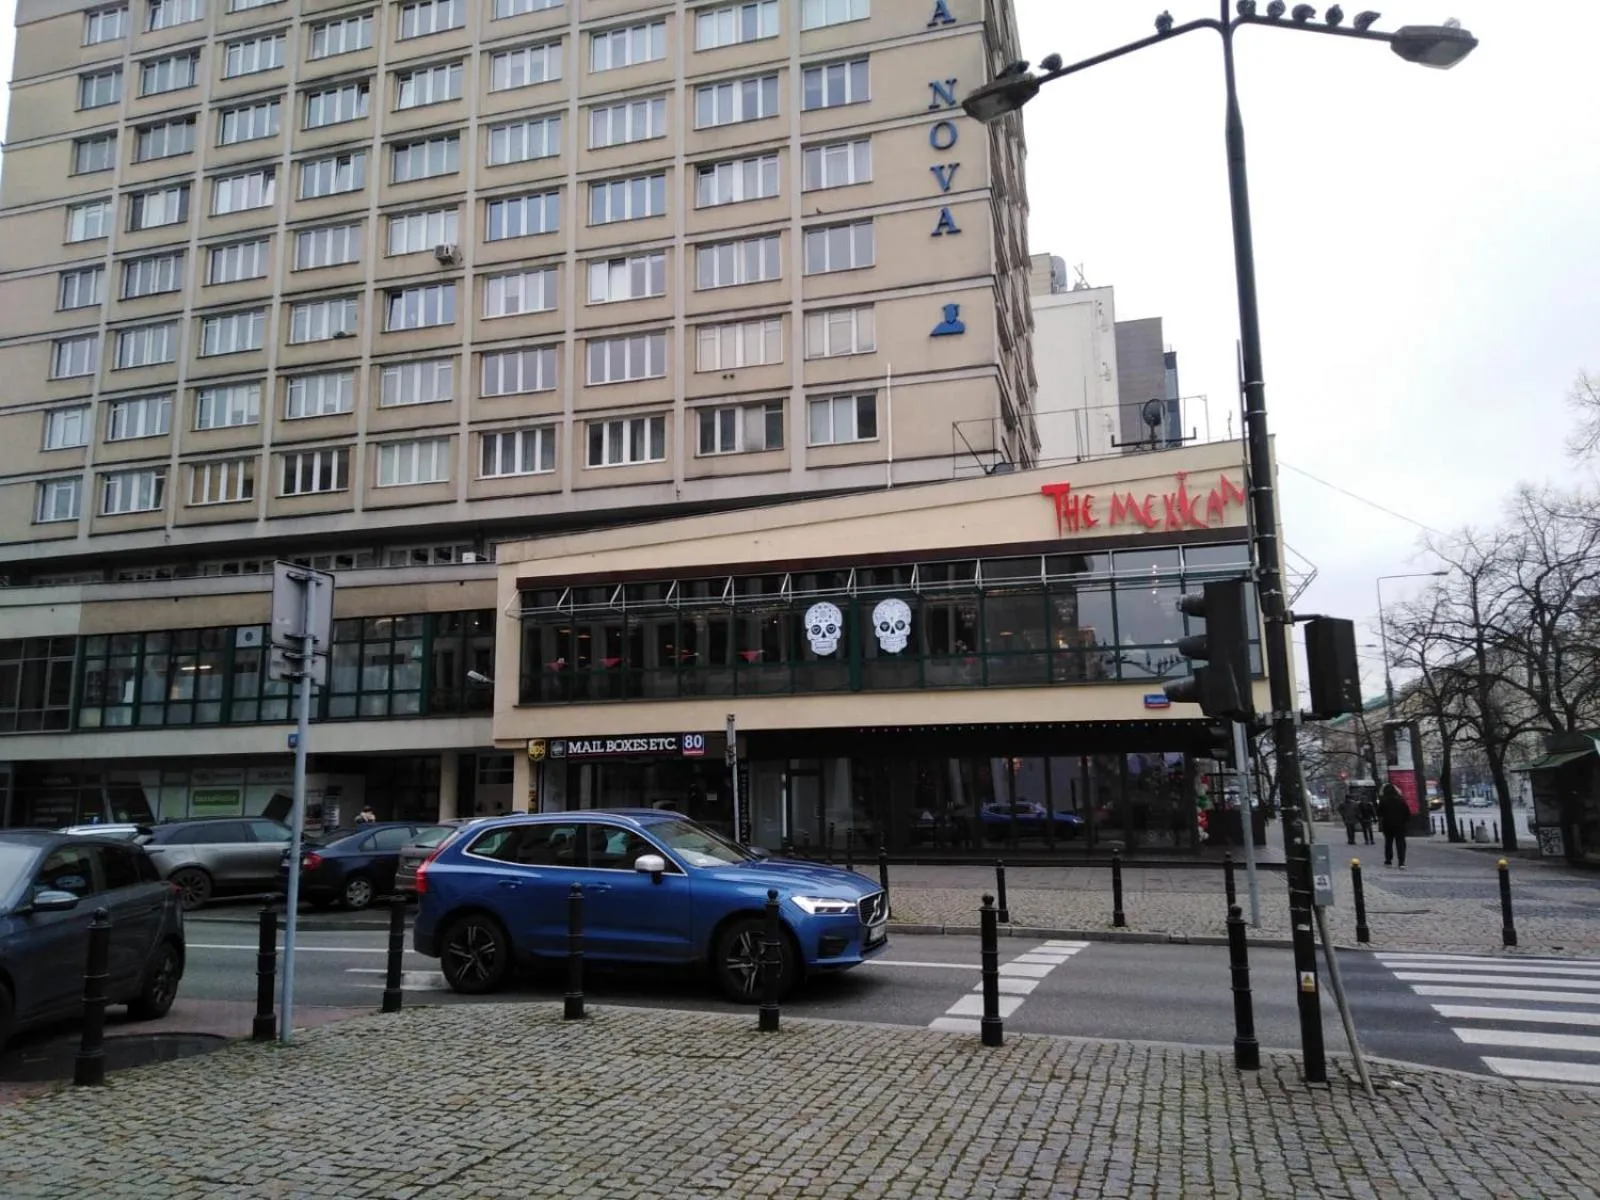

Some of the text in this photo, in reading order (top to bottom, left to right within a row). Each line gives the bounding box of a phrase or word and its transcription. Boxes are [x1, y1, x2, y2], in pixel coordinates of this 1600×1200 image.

[928, 78, 961, 237] NOVA
[568, 741, 605, 754] MAIL
[606, 738, 648, 753] BOXES
[684, 734, 702, 749] 80
